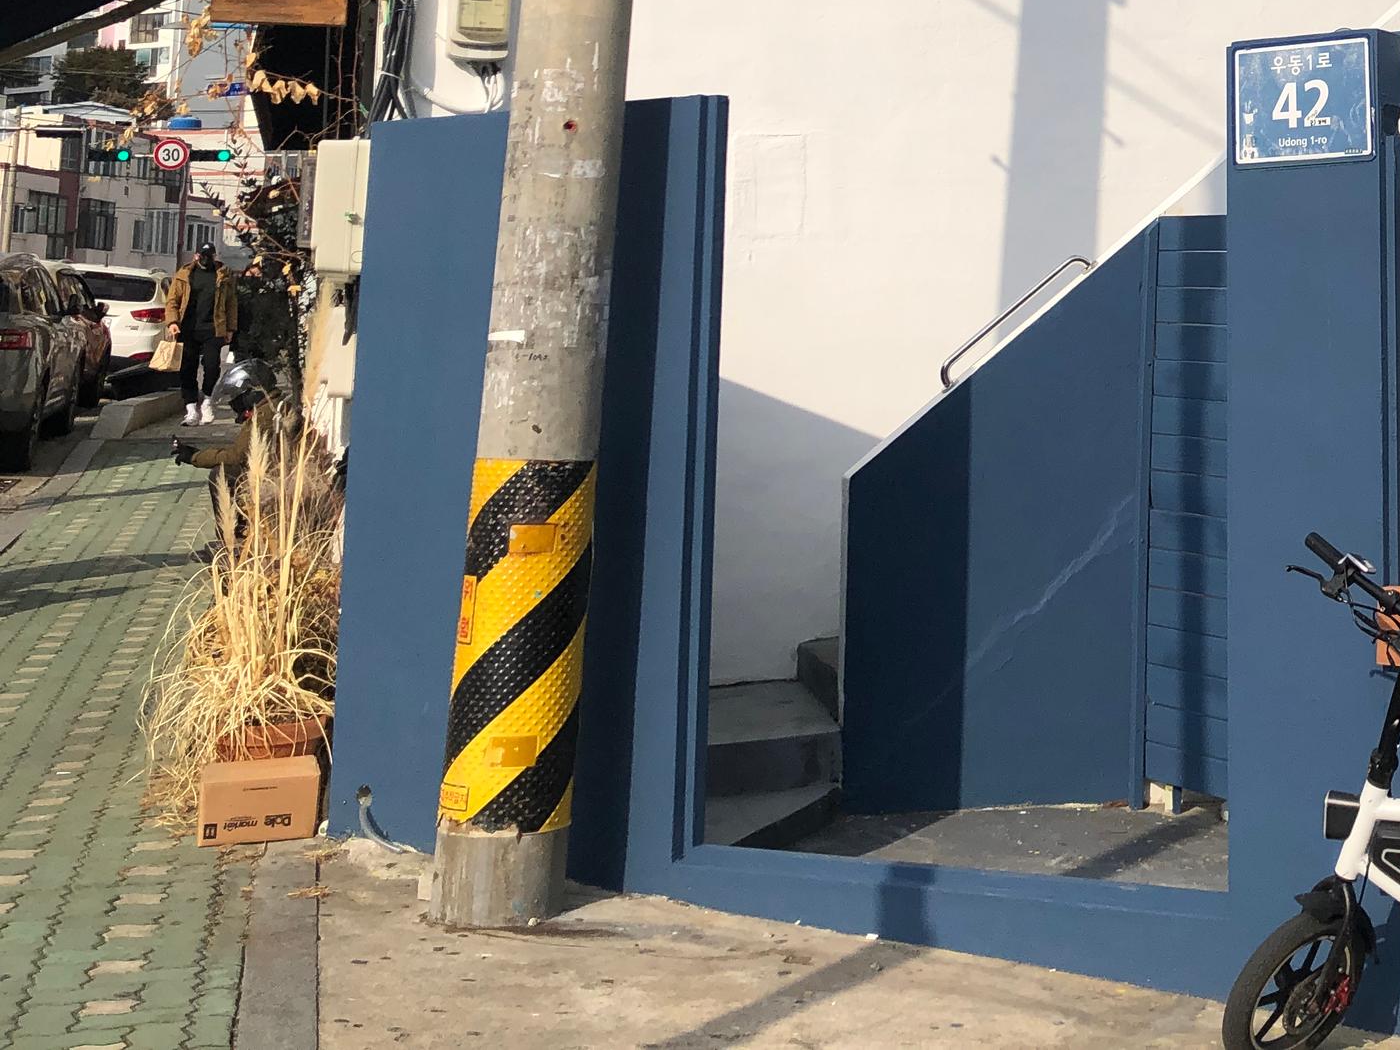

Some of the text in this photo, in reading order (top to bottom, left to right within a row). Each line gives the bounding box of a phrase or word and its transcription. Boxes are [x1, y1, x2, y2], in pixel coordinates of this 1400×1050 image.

[1270, 51, 1333, 76] 우동1로
[1271, 78, 1331, 129] 42
[1278, 135, 1328, 148] Udong 1-ro
[162, 148, 180, 162] 30
[263, 812, 292, 828] Dole
